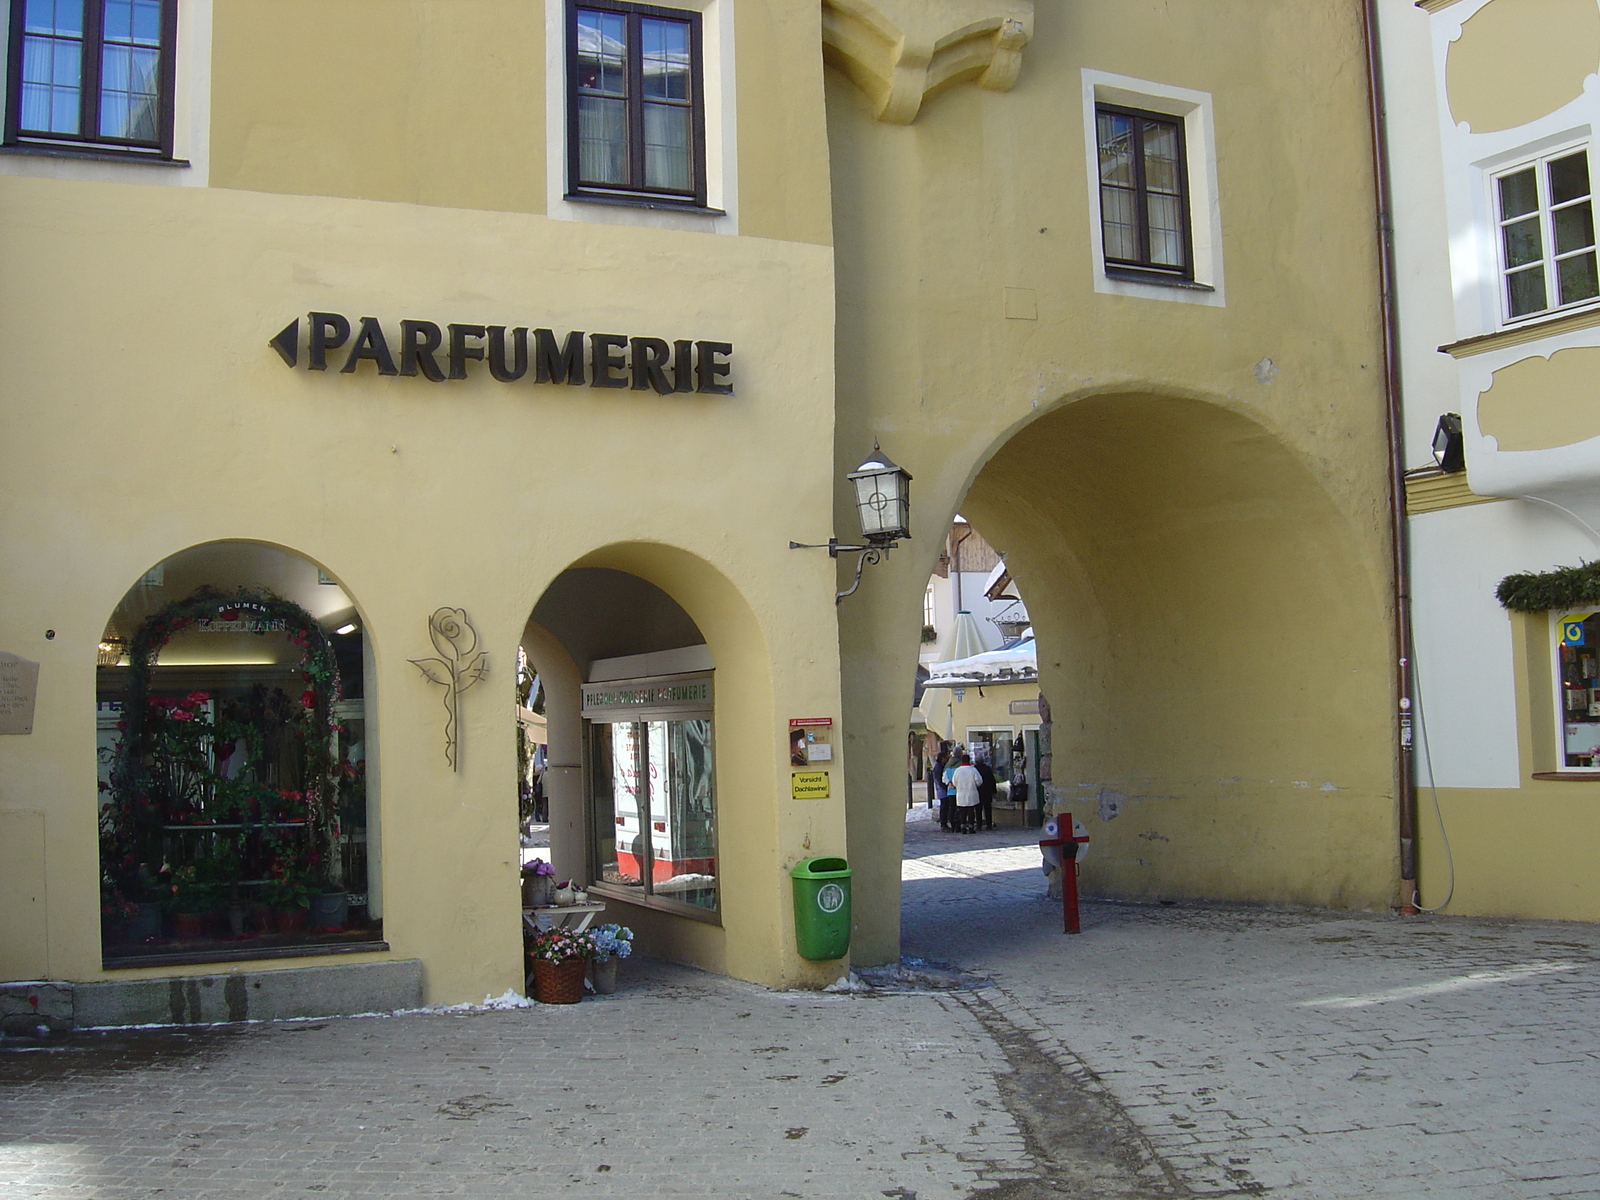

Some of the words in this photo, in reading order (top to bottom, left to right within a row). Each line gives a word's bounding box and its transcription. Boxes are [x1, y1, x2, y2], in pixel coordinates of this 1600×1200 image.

[308, 311, 735, 396] PARFUMERIE
[218, 602, 267, 613] BLUMEN
[198, 618, 287, 632] KOPPELMANN
[657, 684, 707, 701] PARFUMERIE
